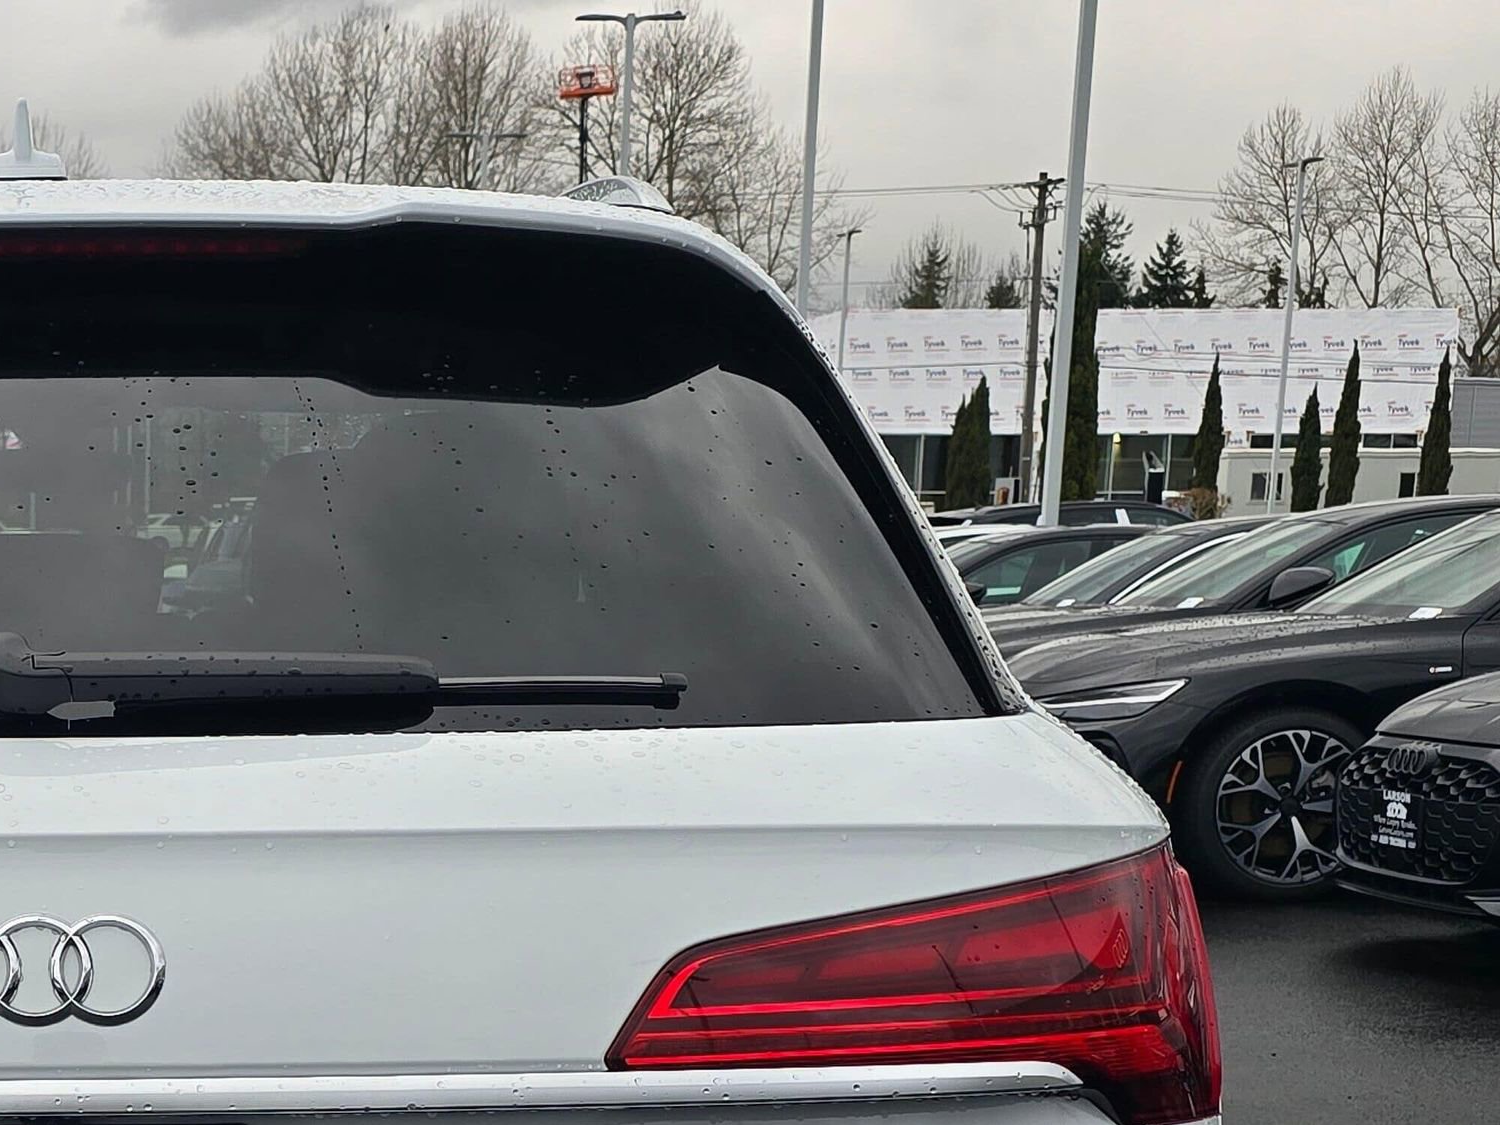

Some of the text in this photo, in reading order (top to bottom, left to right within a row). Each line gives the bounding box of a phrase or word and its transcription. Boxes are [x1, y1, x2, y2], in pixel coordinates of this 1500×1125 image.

[1323, 340, 1345, 349] Tyvek
[1361, 339, 1382, 348] Tyvek
[1398, 338, 1420, 347] Tyvek
[1238, 407, 1260, 416] Tyvek
